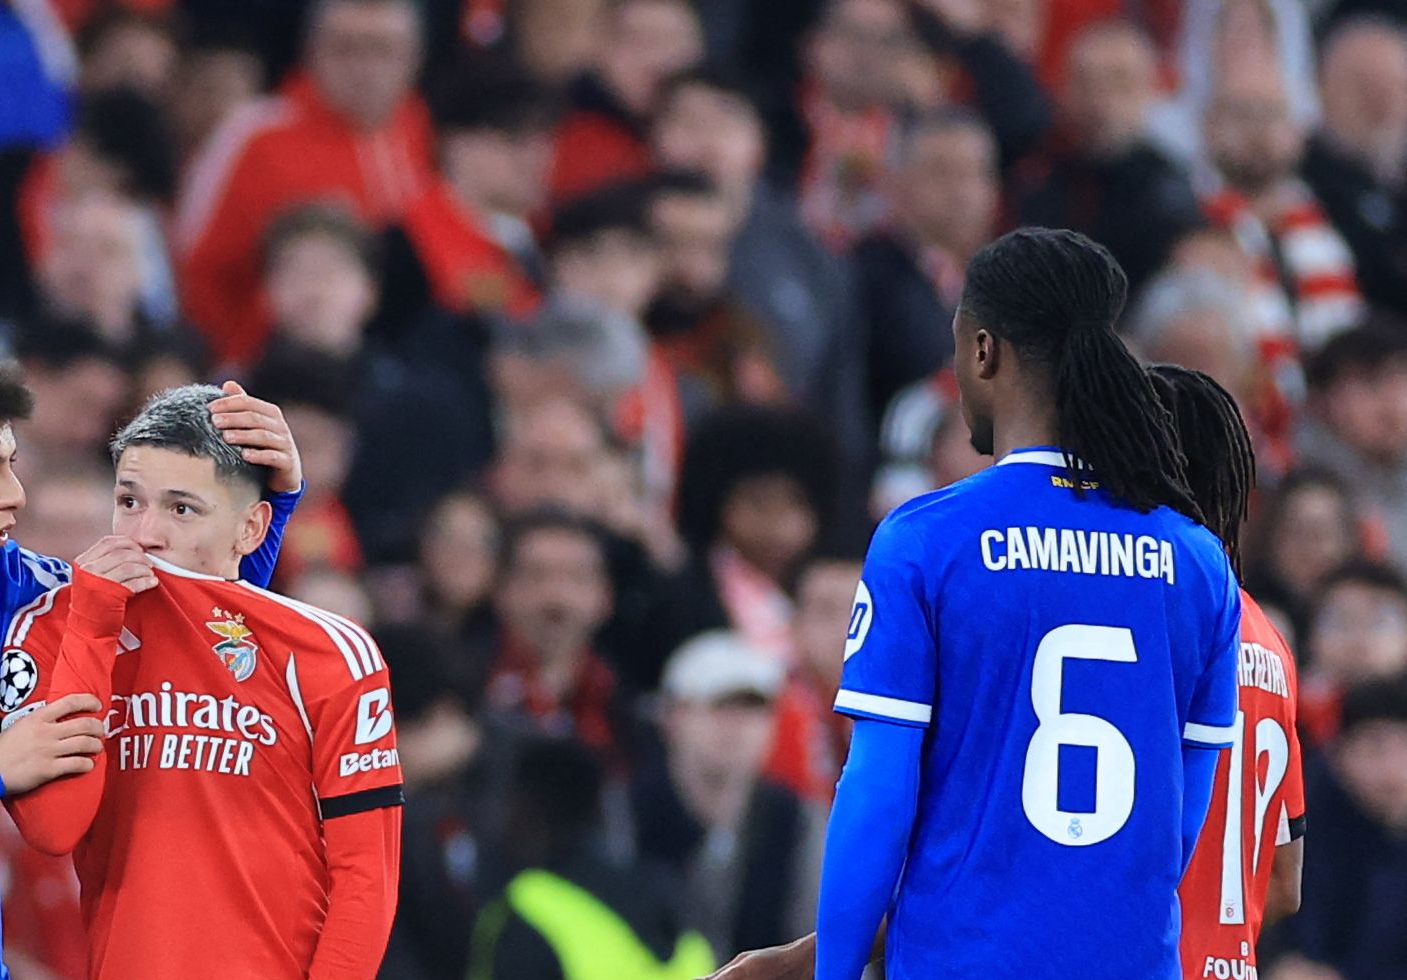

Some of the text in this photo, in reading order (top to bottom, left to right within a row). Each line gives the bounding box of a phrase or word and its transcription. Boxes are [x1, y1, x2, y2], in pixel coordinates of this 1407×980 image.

[980, 526, 1175, 585] CAMAVINGA
[120, 734, 254, 776] FLY BETTER
[1021, 623, 1138, 847] 6
